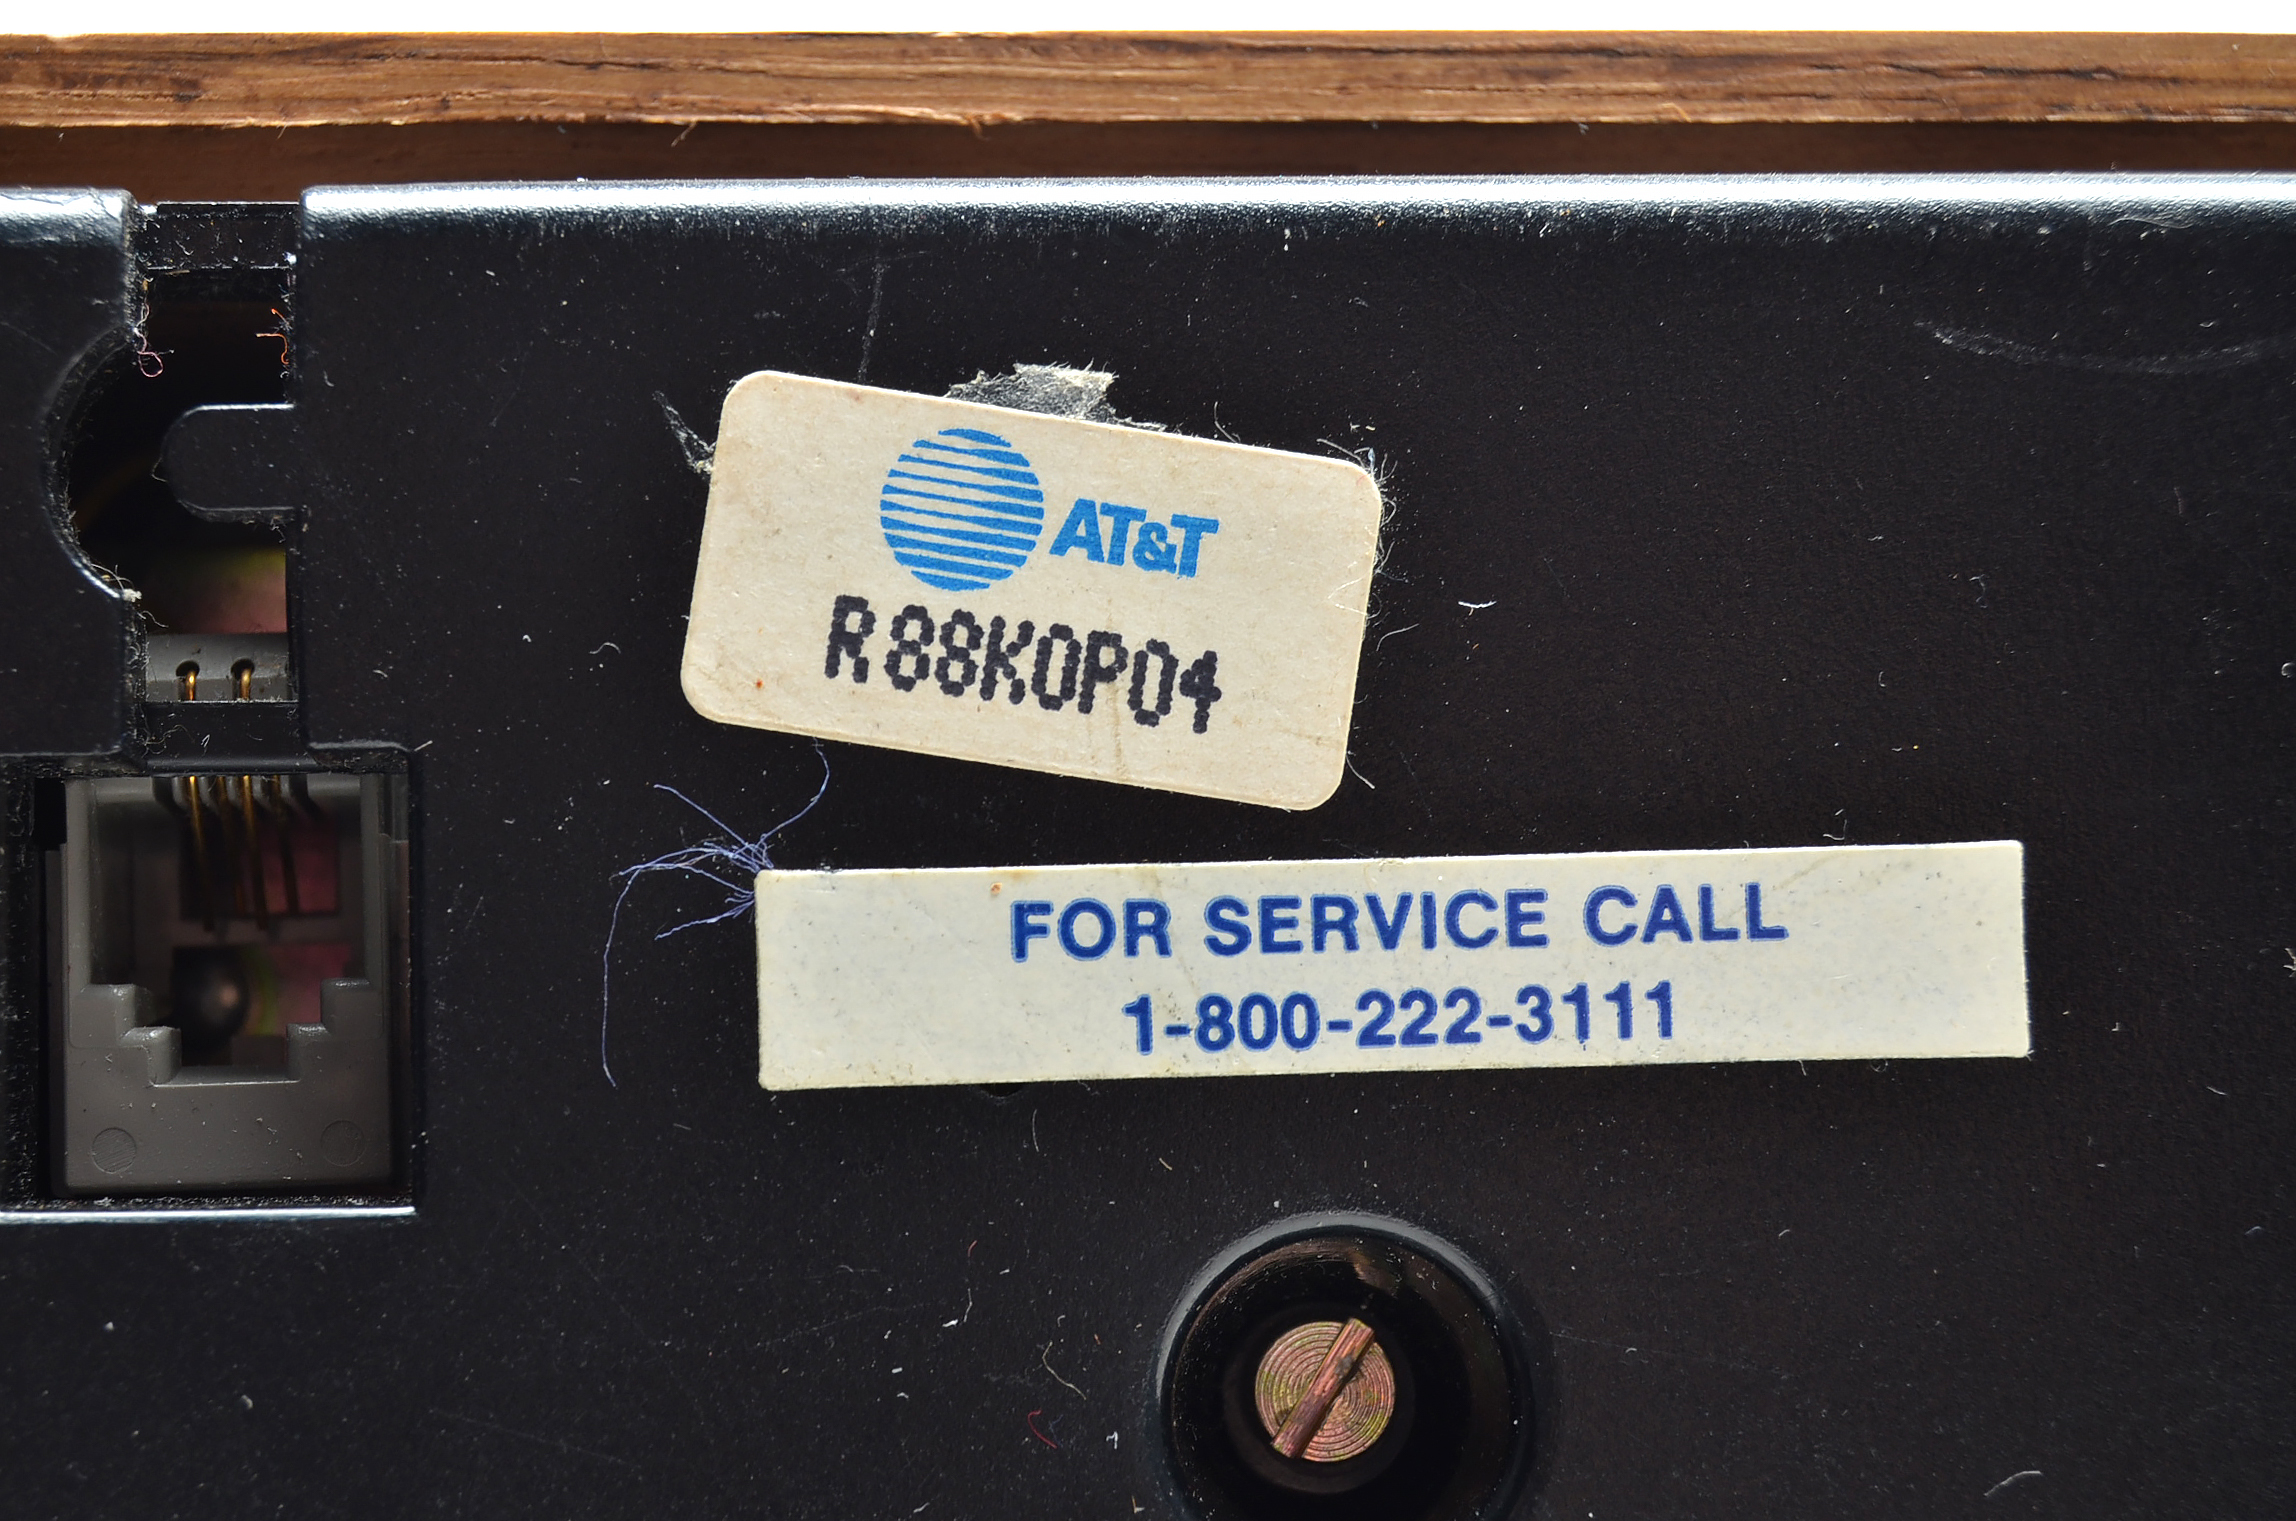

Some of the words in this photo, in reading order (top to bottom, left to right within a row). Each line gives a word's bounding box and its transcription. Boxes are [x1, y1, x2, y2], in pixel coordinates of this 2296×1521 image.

[1050, 498, 1220, 579] AT&T
[1010, 898, 1173, 964] FOR
[1203, 888, 1551, 958] SERVICE
[1583, 881, 1790, 947] CALL
[1122, 979, 1674, 1056] 1-800-222-3111
